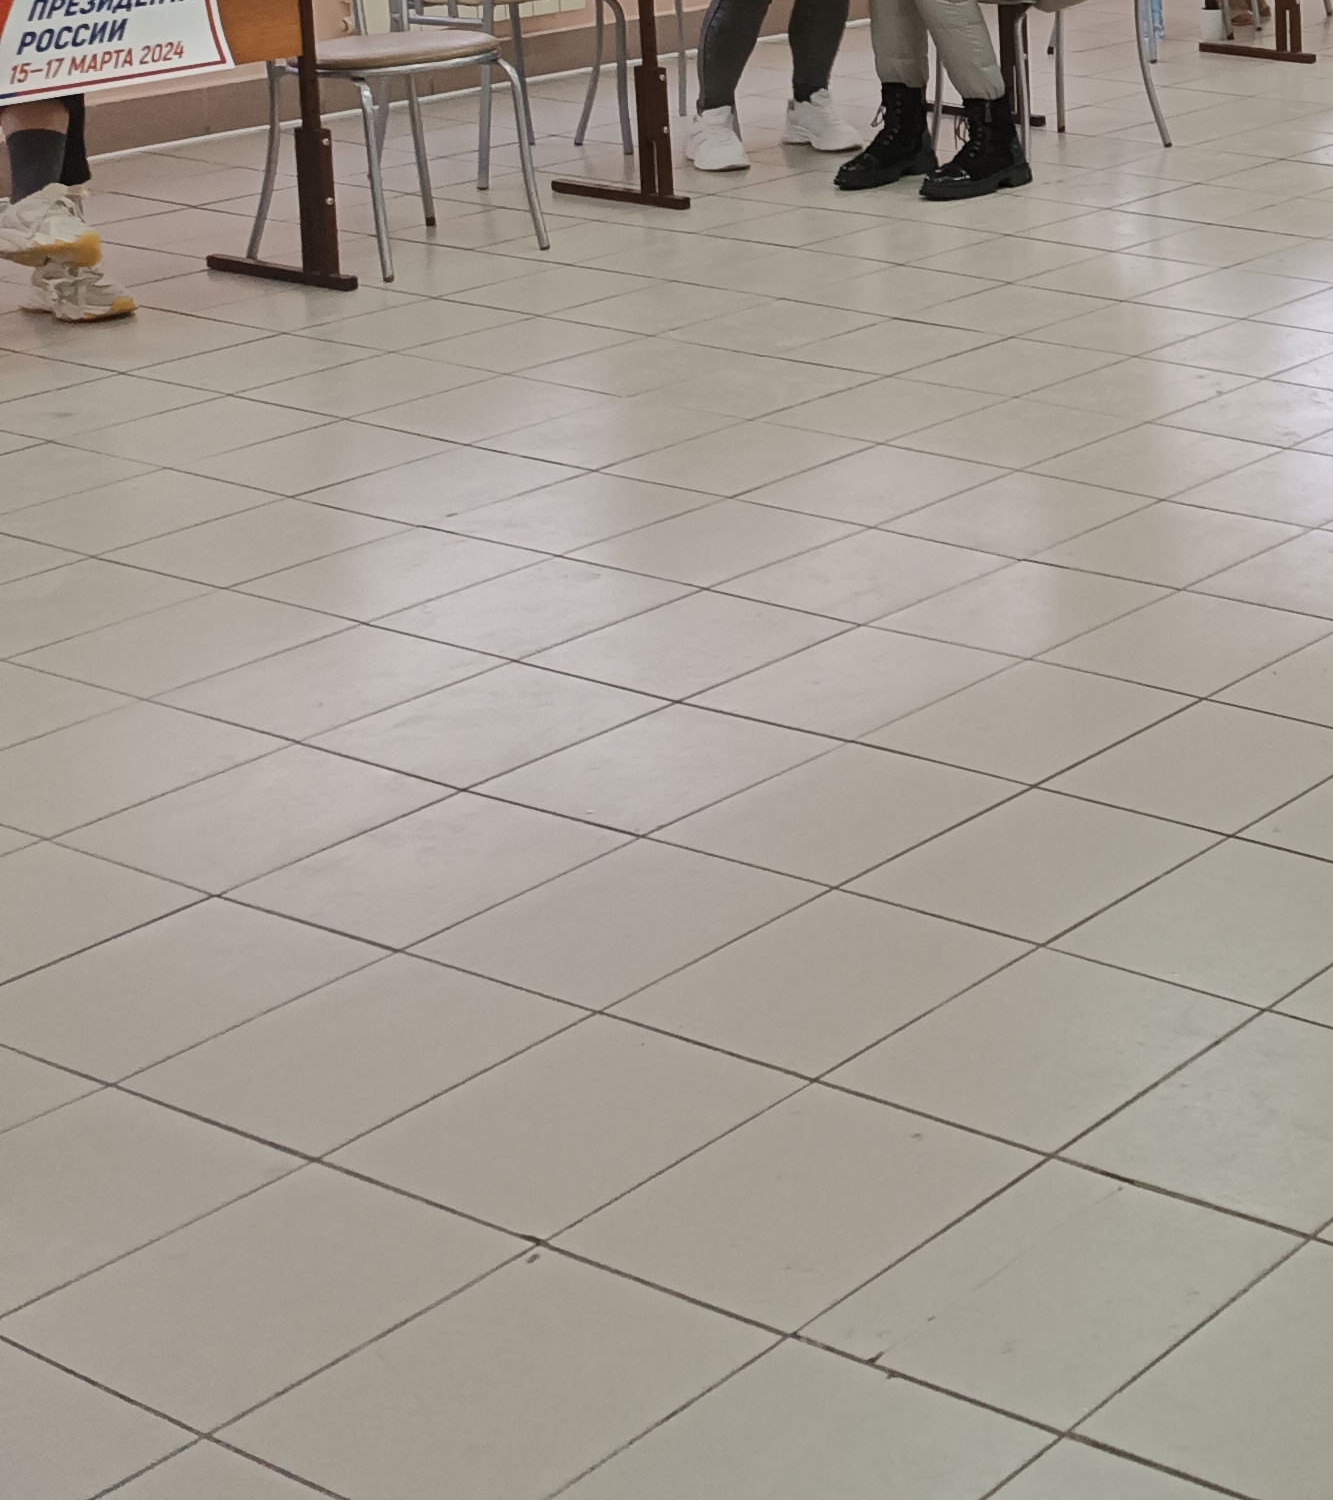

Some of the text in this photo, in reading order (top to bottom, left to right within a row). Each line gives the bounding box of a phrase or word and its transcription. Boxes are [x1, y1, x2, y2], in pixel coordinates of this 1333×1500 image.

[16, 18, 129, 55] РОССИИ
[67, 48, 134, 77] МАРТА
[139, 40, 186, 66] 2024
